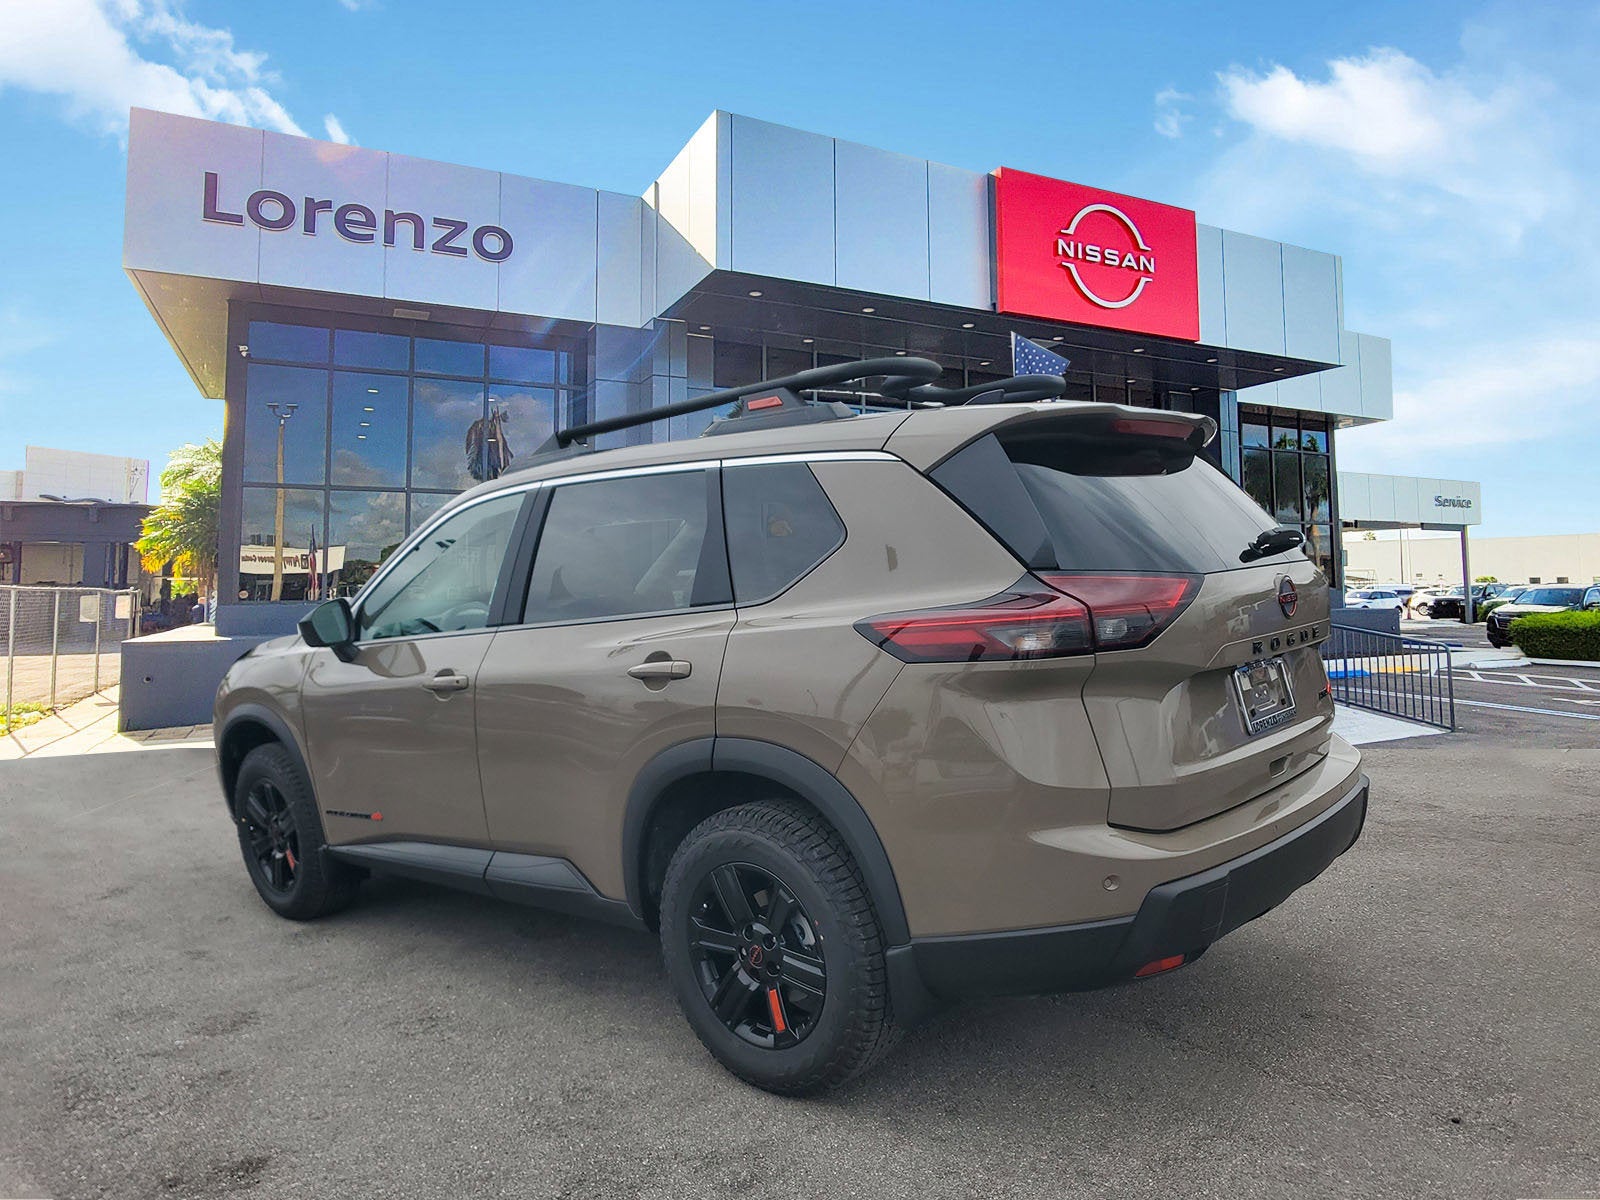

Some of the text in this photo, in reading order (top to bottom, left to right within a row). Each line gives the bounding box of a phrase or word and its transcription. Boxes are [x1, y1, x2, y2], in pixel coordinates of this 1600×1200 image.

[202, 171, 514, 262] Lorenzo
[1057, 238, 1155, 273] NISSAN
[1434, 495, 1472, 509] Service
[1252, 625, 1320, 654] ROGUE
